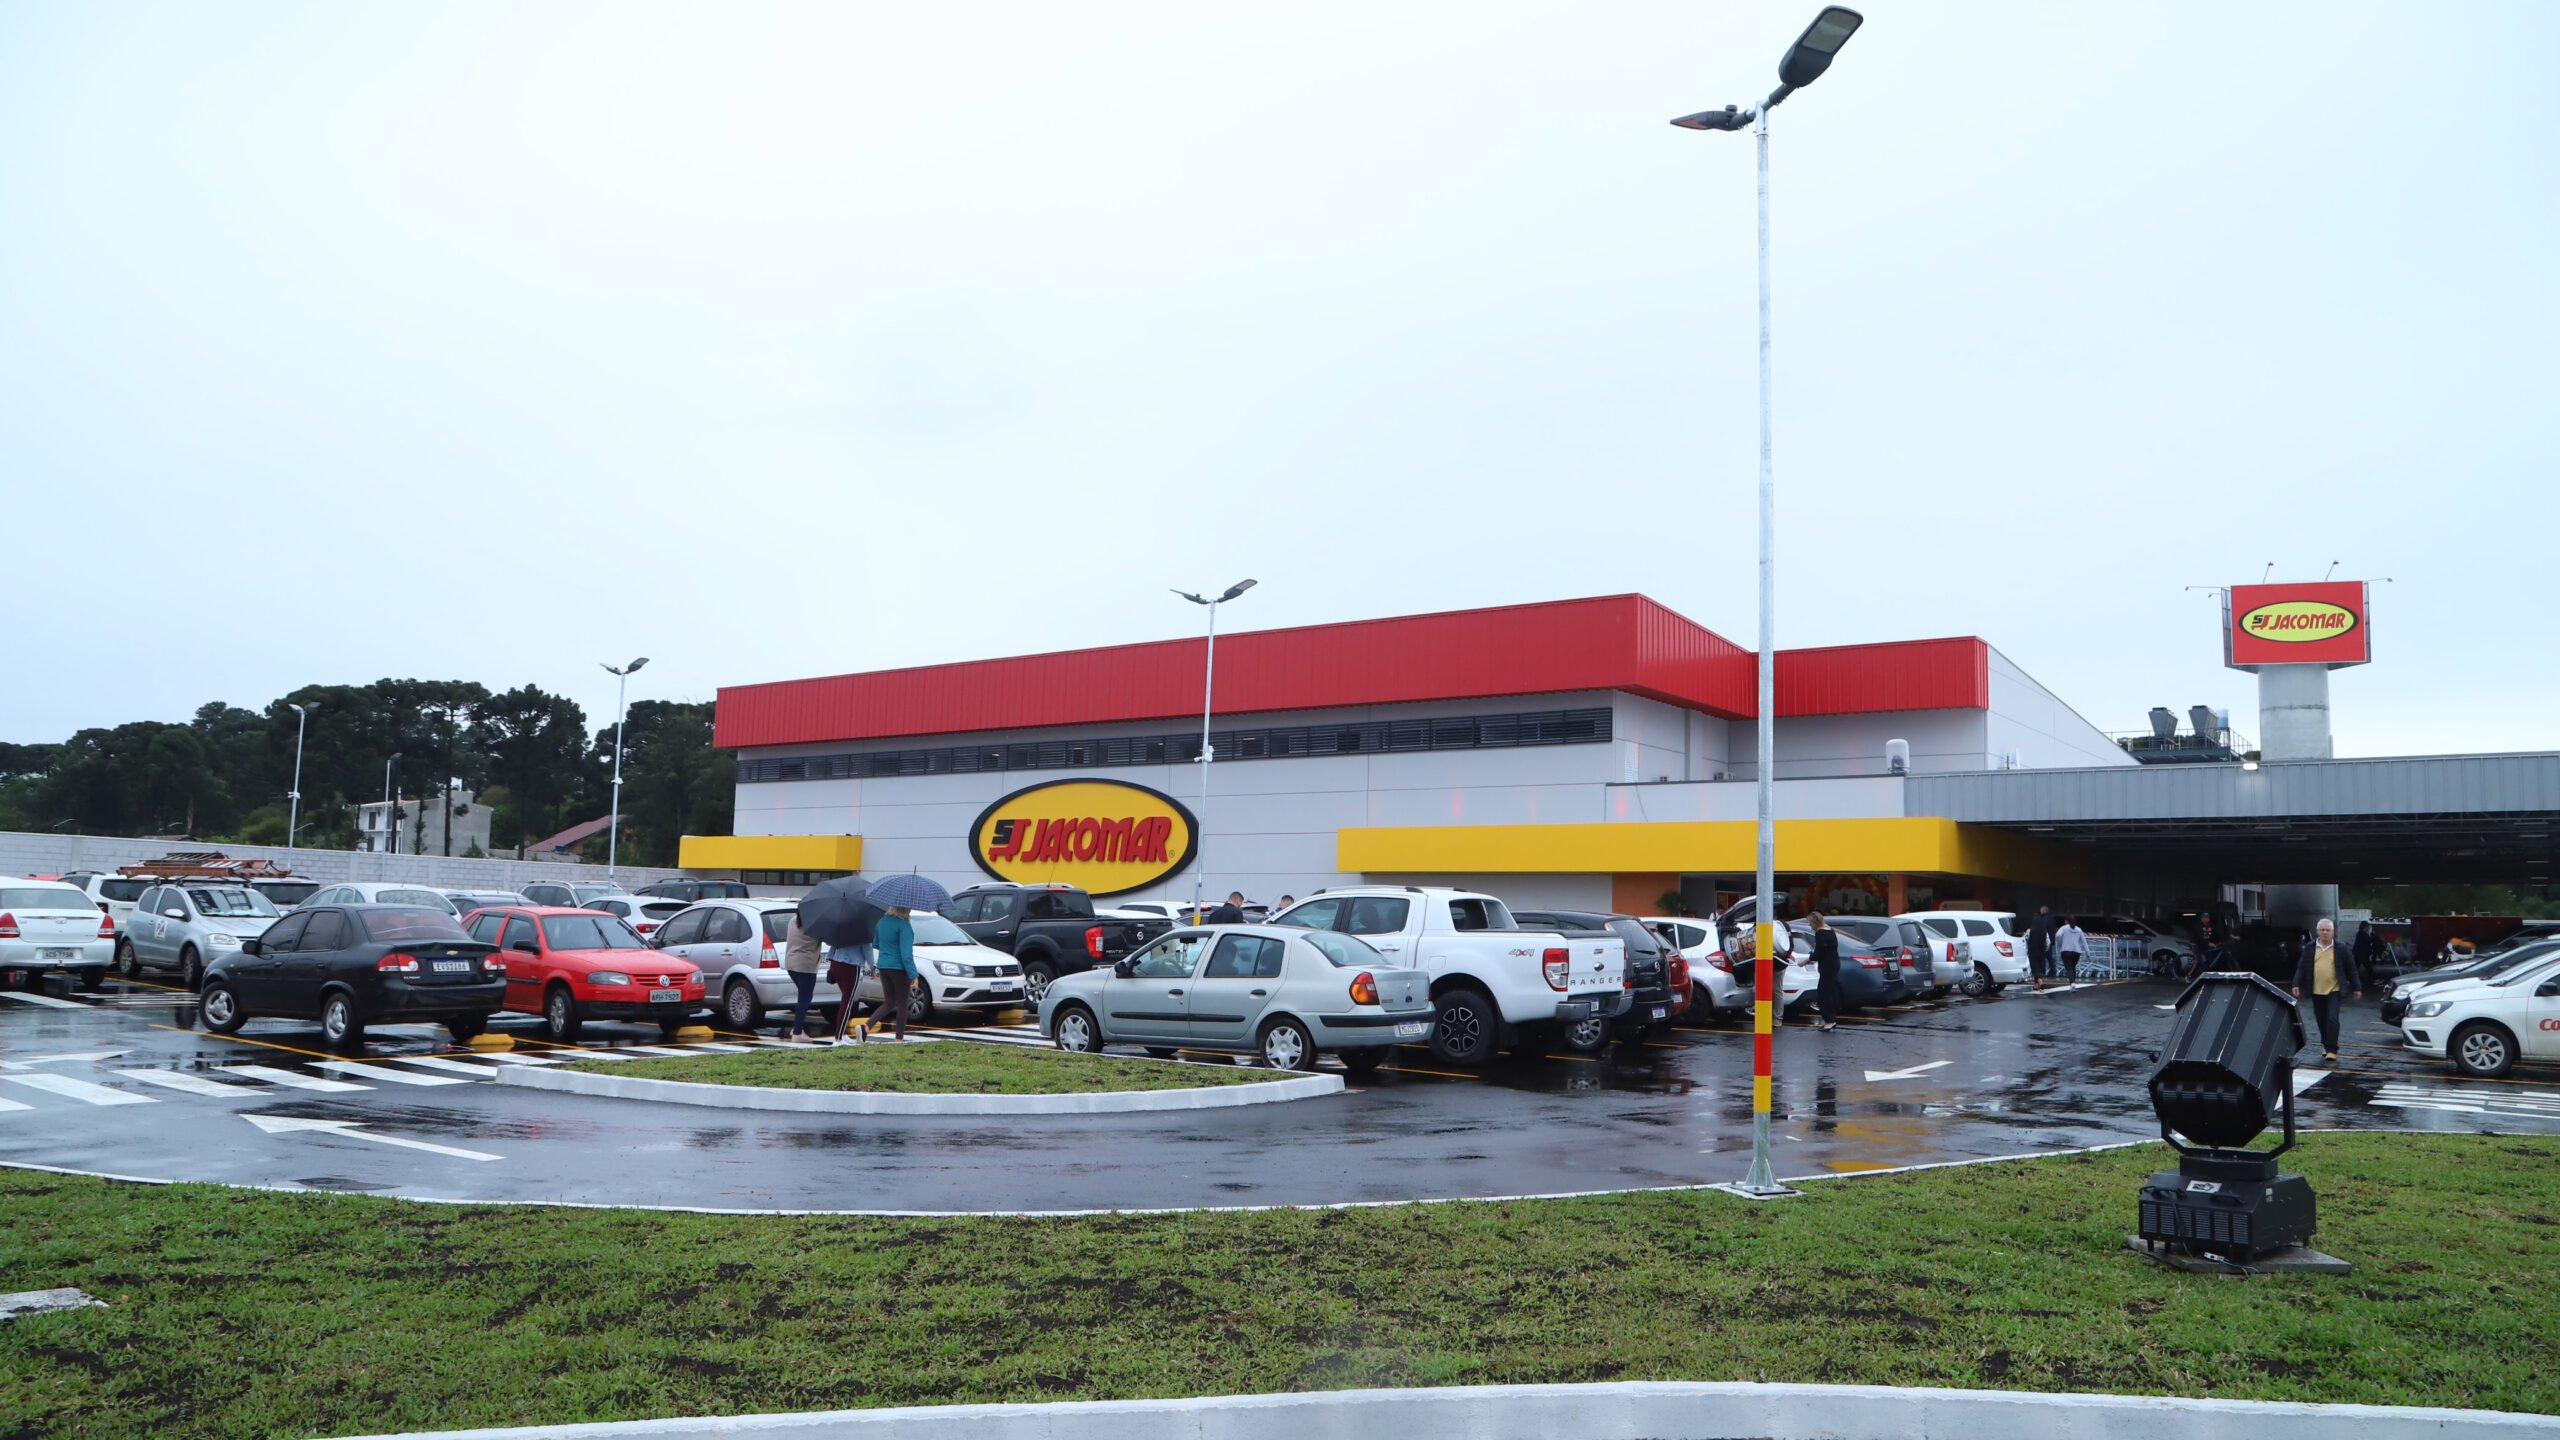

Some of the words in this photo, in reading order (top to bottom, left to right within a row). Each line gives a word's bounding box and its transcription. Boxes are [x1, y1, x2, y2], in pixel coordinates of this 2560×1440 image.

[2269, 613, 2346, 630] JACOMAR
[1020, 817, 1172, 862] JACOMAR
[1570, 976, 1622, 986] RANGER
